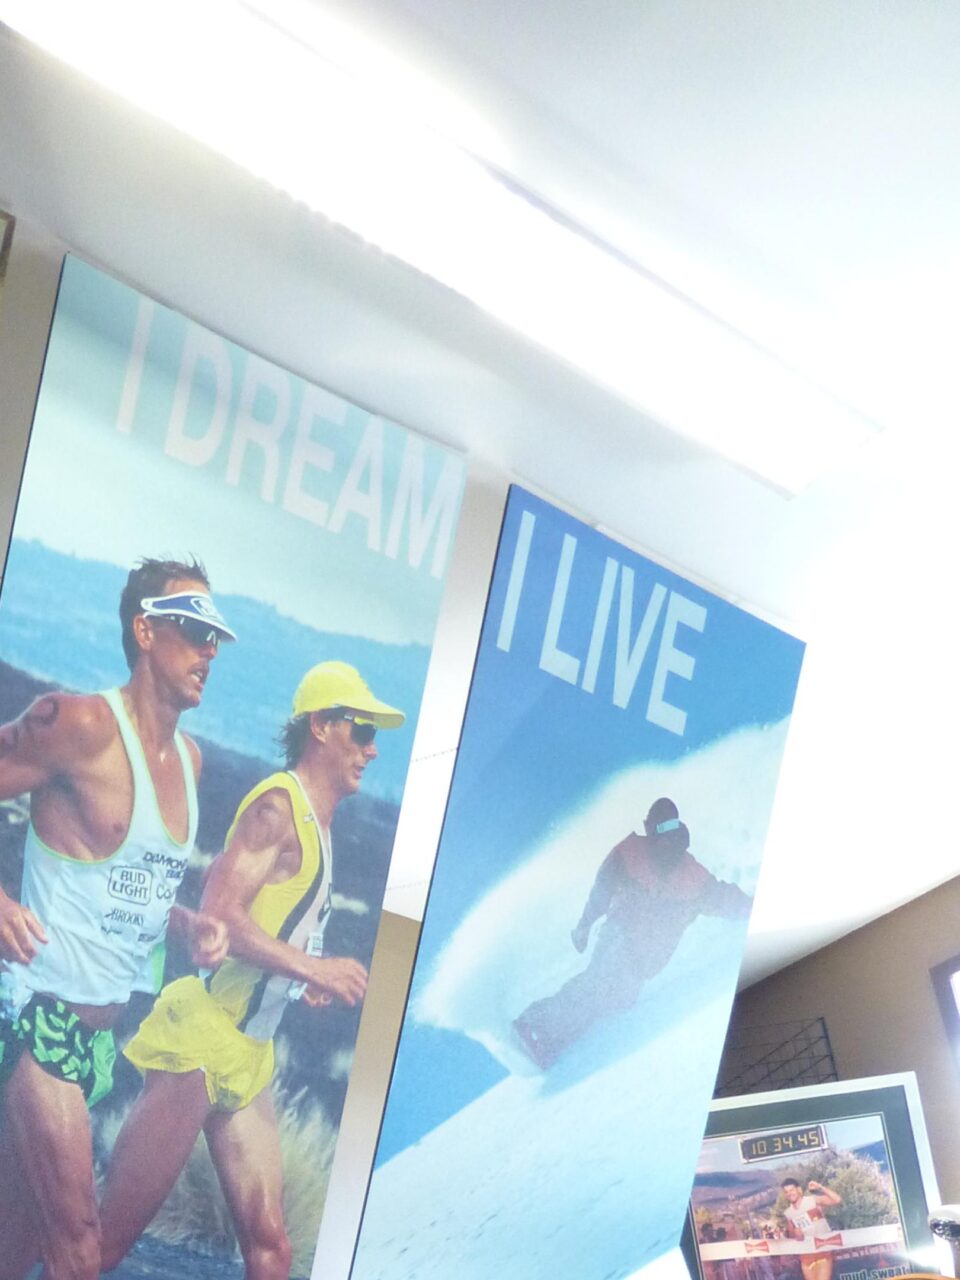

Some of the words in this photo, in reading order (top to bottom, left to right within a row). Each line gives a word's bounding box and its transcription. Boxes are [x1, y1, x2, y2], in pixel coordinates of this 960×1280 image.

[115, 303, 154, 434] I
[165, 328, 468, 580] DREAM
[497, 509, 537, 652] I
[540, 536, 708, 737] LIVE
[112, 881, 148, 899] LIGHT
[120, 870, 146, 885] BUD
[752, 1140, 767, 1155] 10
[798, 1130, 819, 1146] 45
